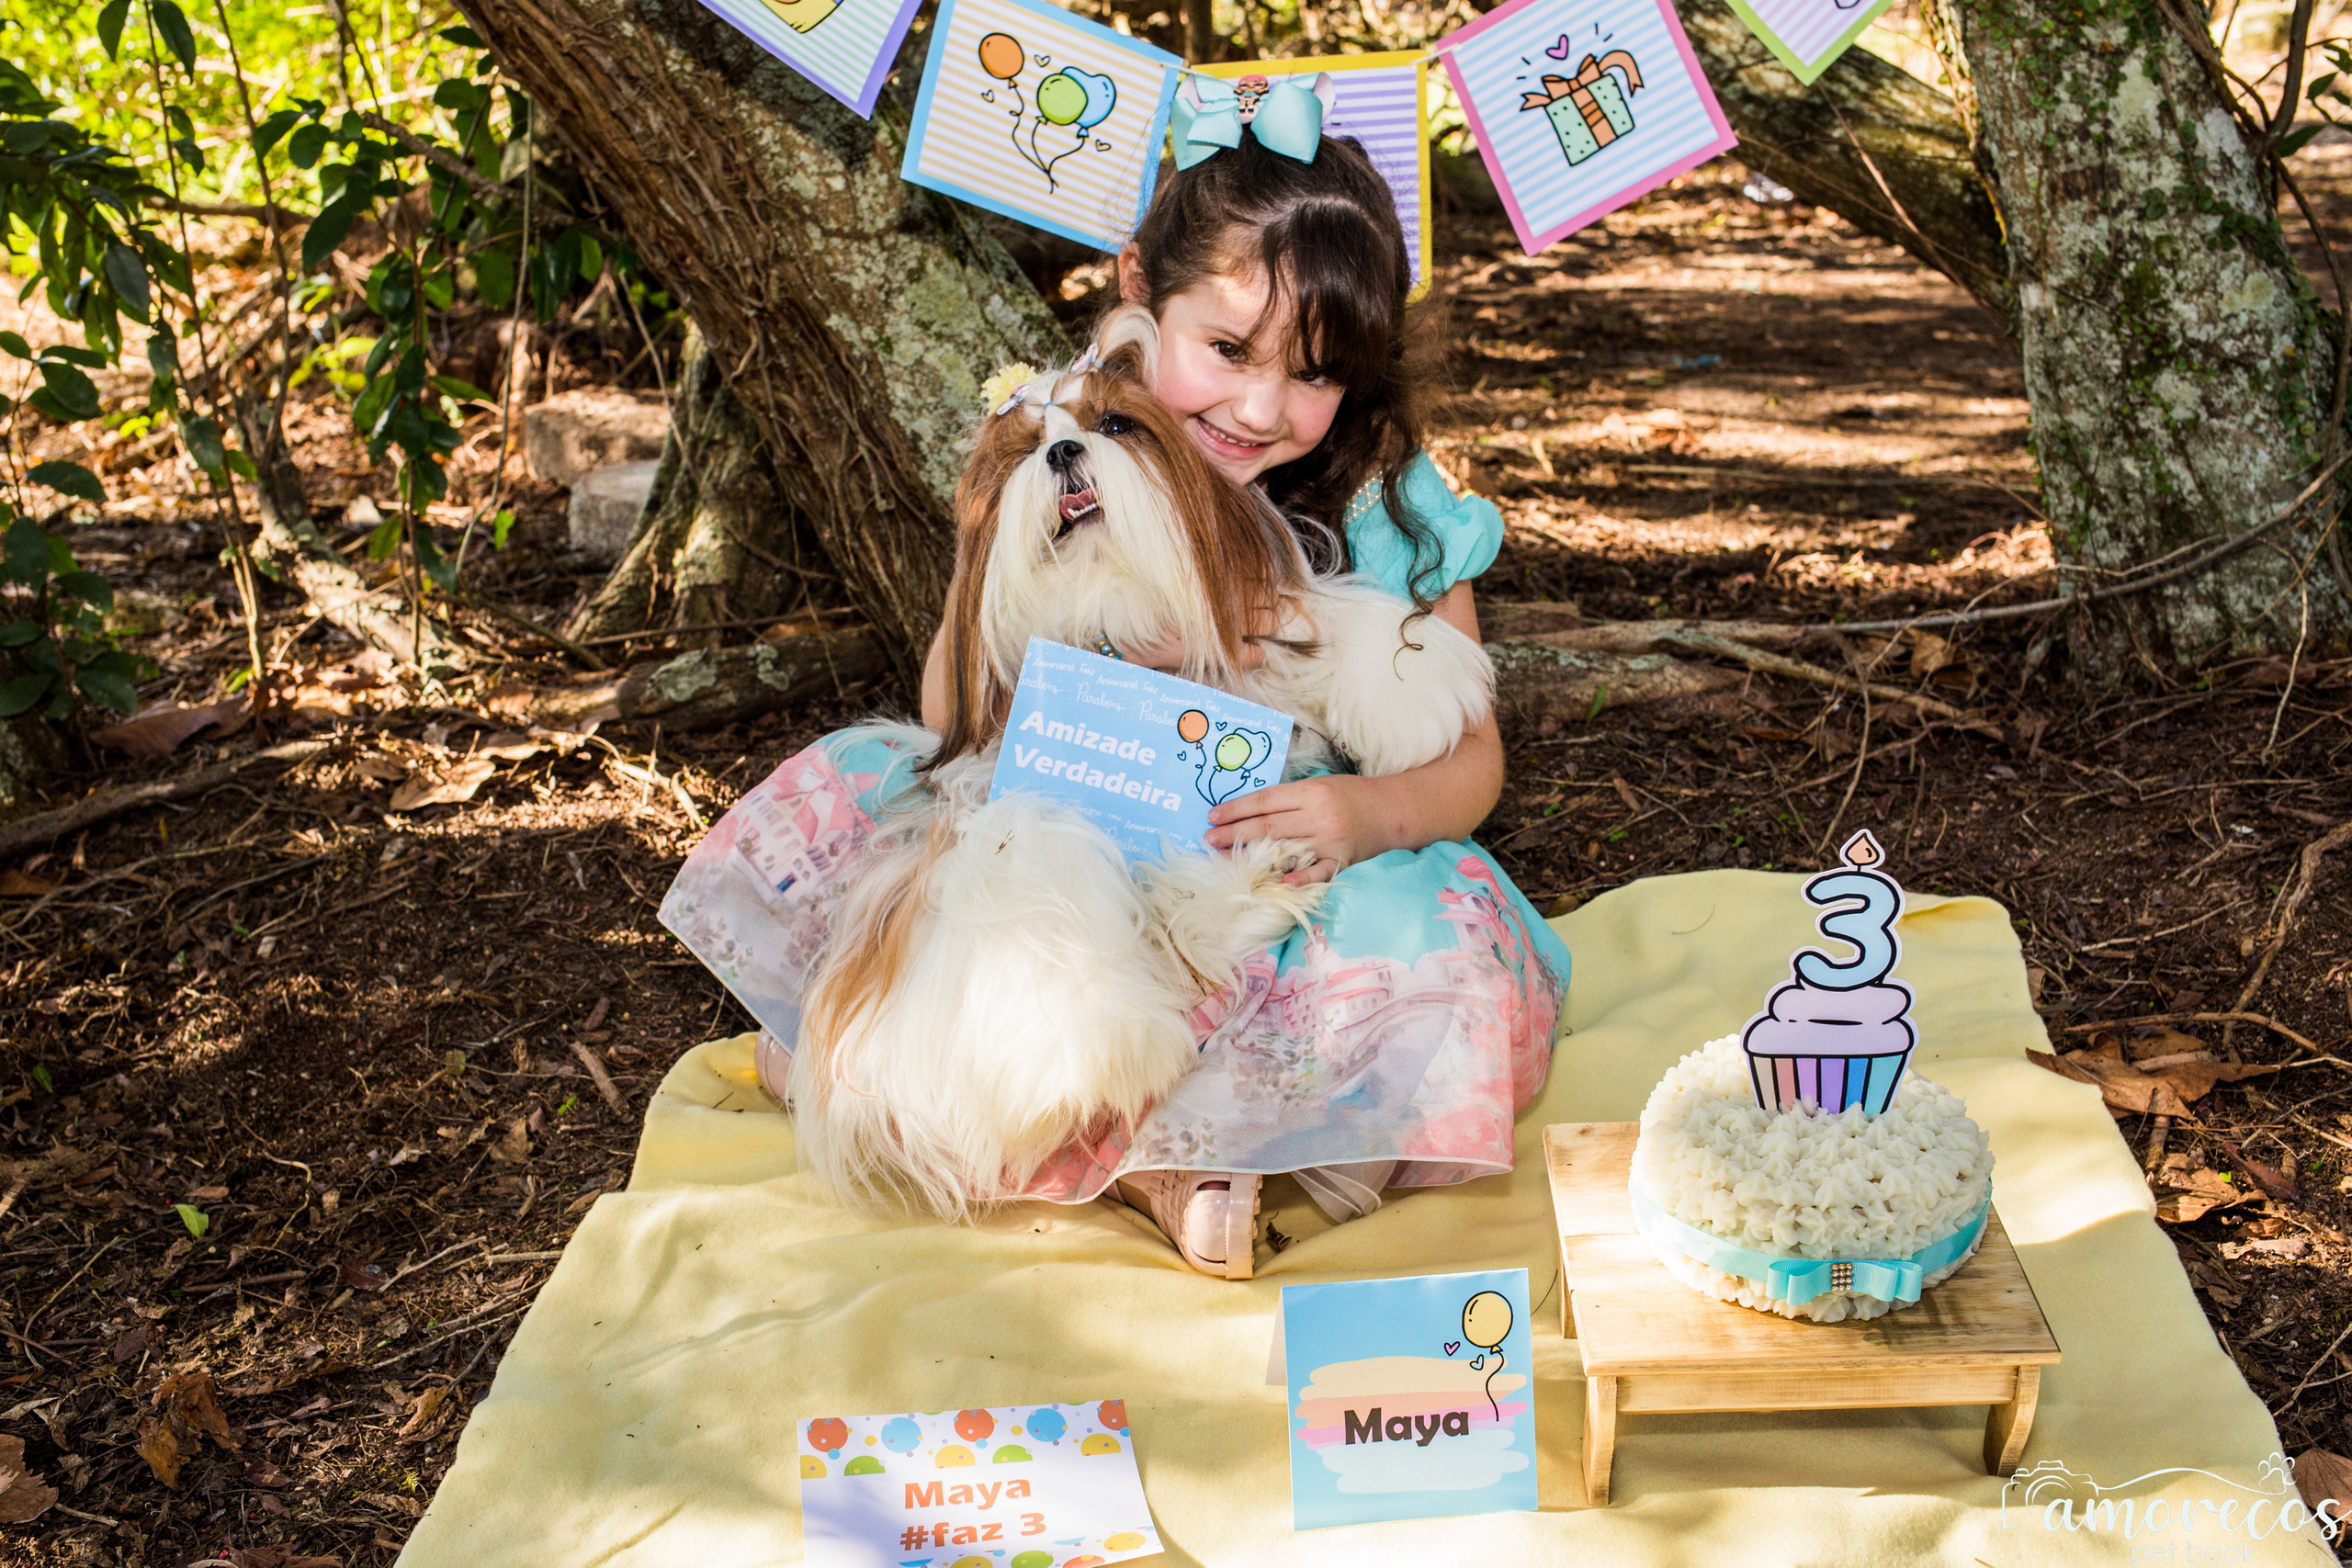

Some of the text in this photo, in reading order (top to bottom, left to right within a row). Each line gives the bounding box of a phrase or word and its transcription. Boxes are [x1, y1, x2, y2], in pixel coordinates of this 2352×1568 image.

[1018, 710, 1158, 767] Amizade
[1013, 743, 1182, 813] Verdadeira
[1793, 871, 1900, 992] 3
[1343, 1406, 1469, 1448] Maya
[904, 1478, 1032, 1511] Maya
[899, 1512, 1047, 1551] #faz 3
